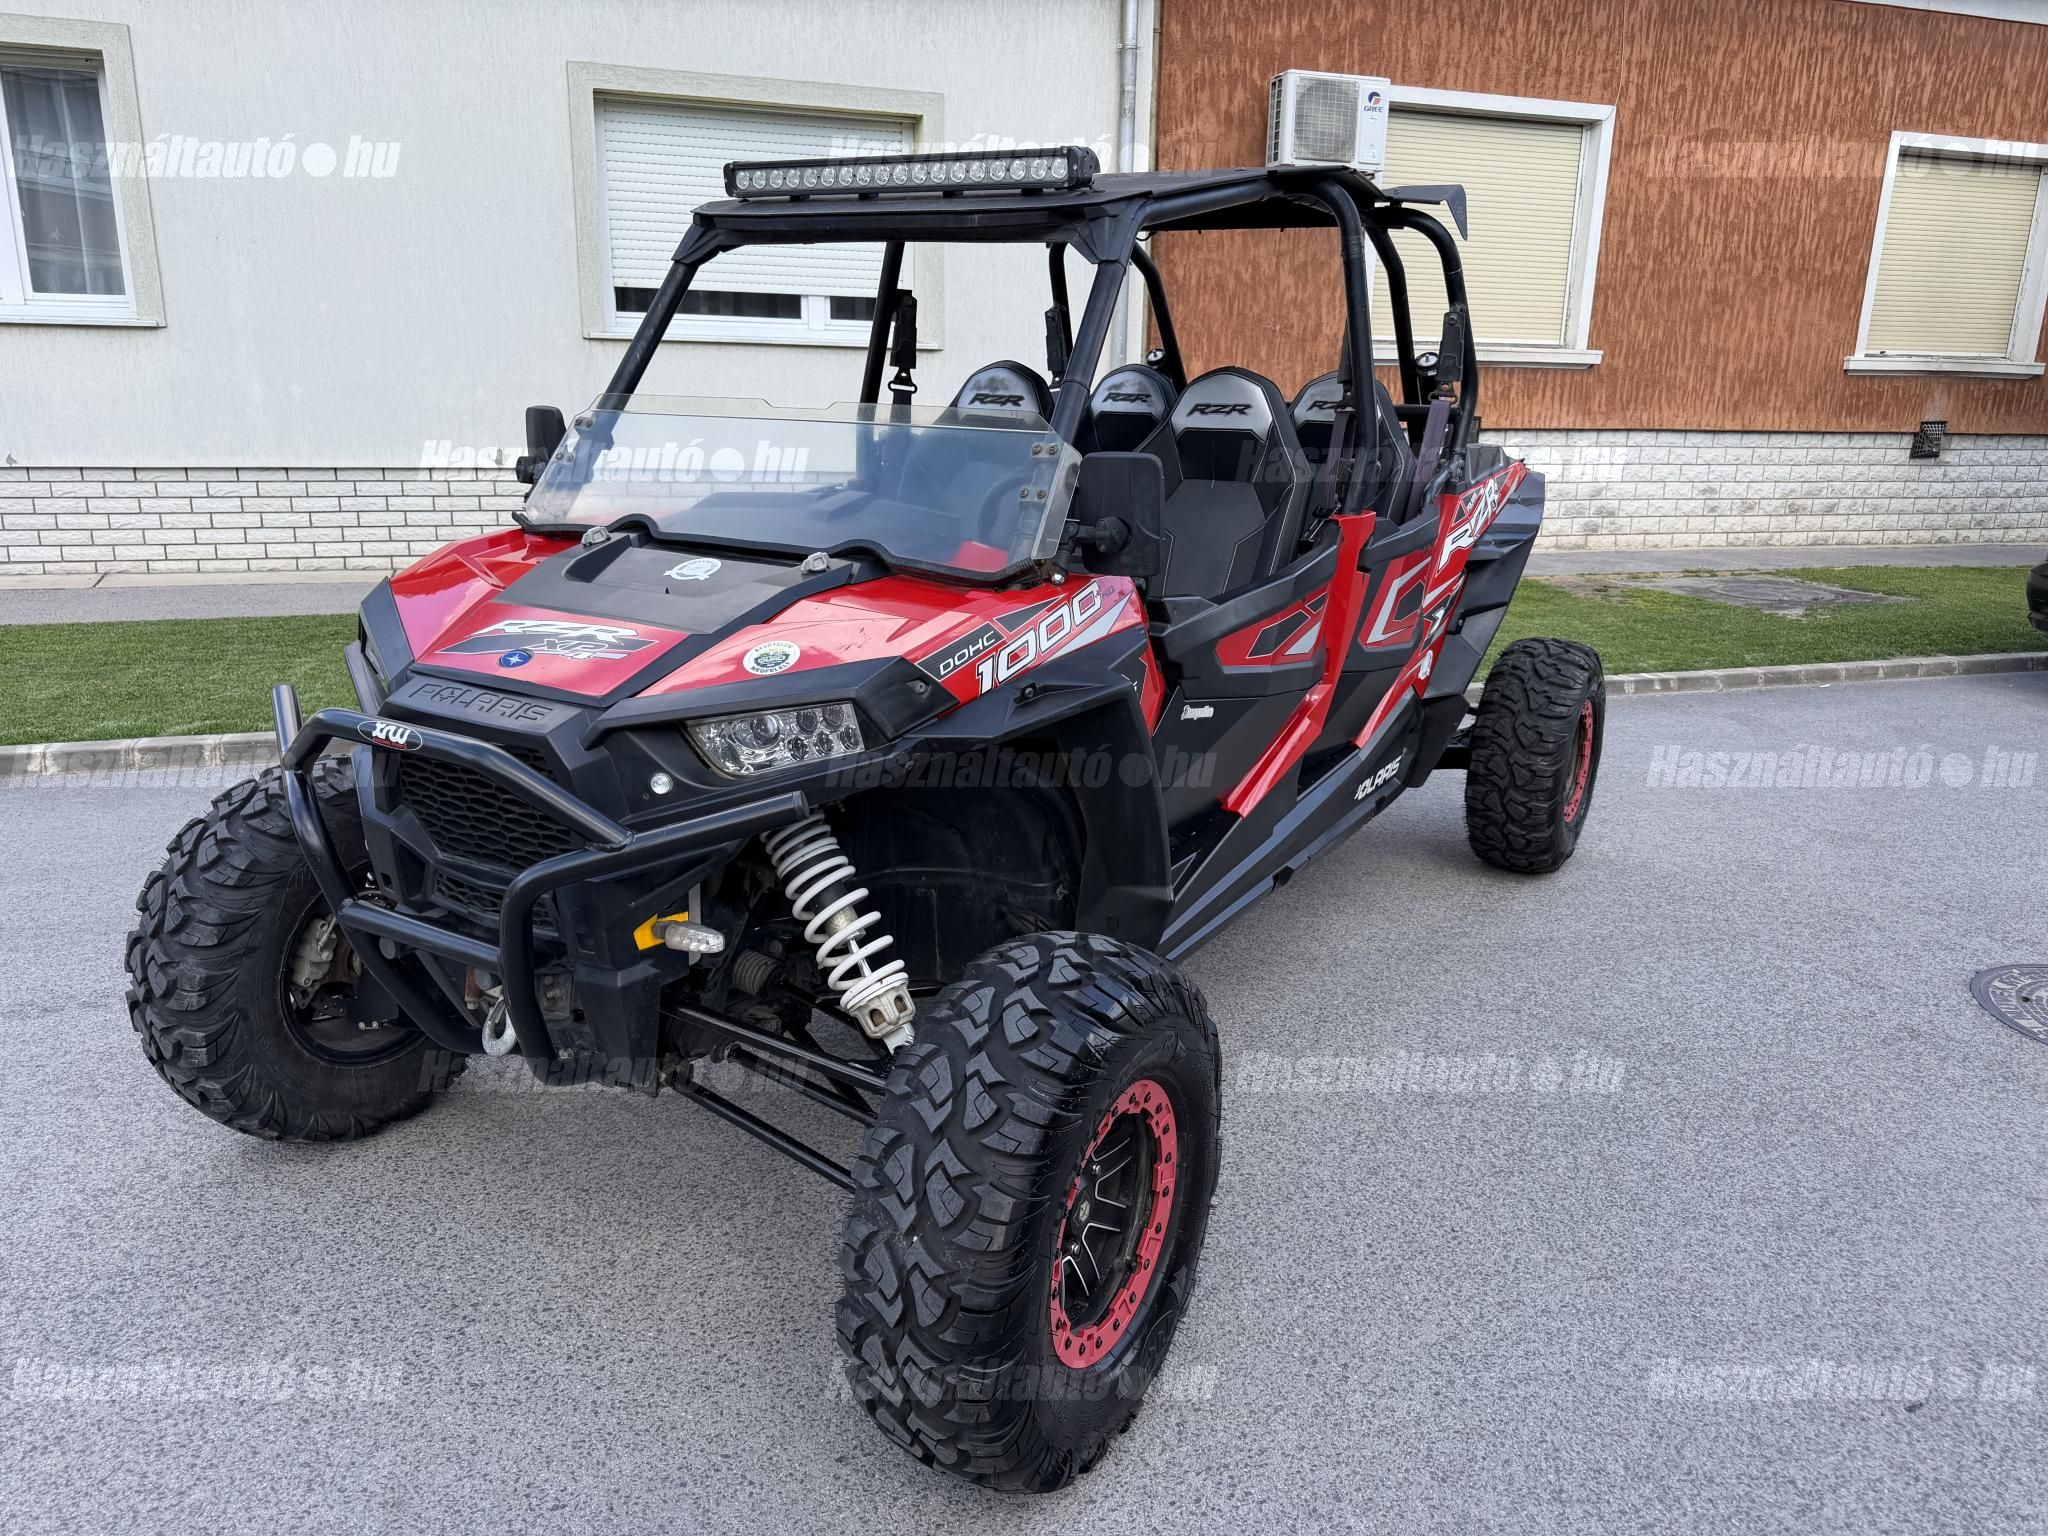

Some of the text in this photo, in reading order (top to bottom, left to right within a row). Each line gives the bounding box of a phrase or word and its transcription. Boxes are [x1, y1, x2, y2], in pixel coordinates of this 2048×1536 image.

[1363, 105, 1384, 113] GREE
[967, 392, 1025, 408] RZR
[1101, 391, 1153, 404] RZR
[1186, 402, 1254, 417] RZR
[464, 618, 641, 645] RZR
[977, 581, 1103, 695] 1000
[939, 630, 994, 676] DOHC
[408, 682, 555, 722] POLARIS
